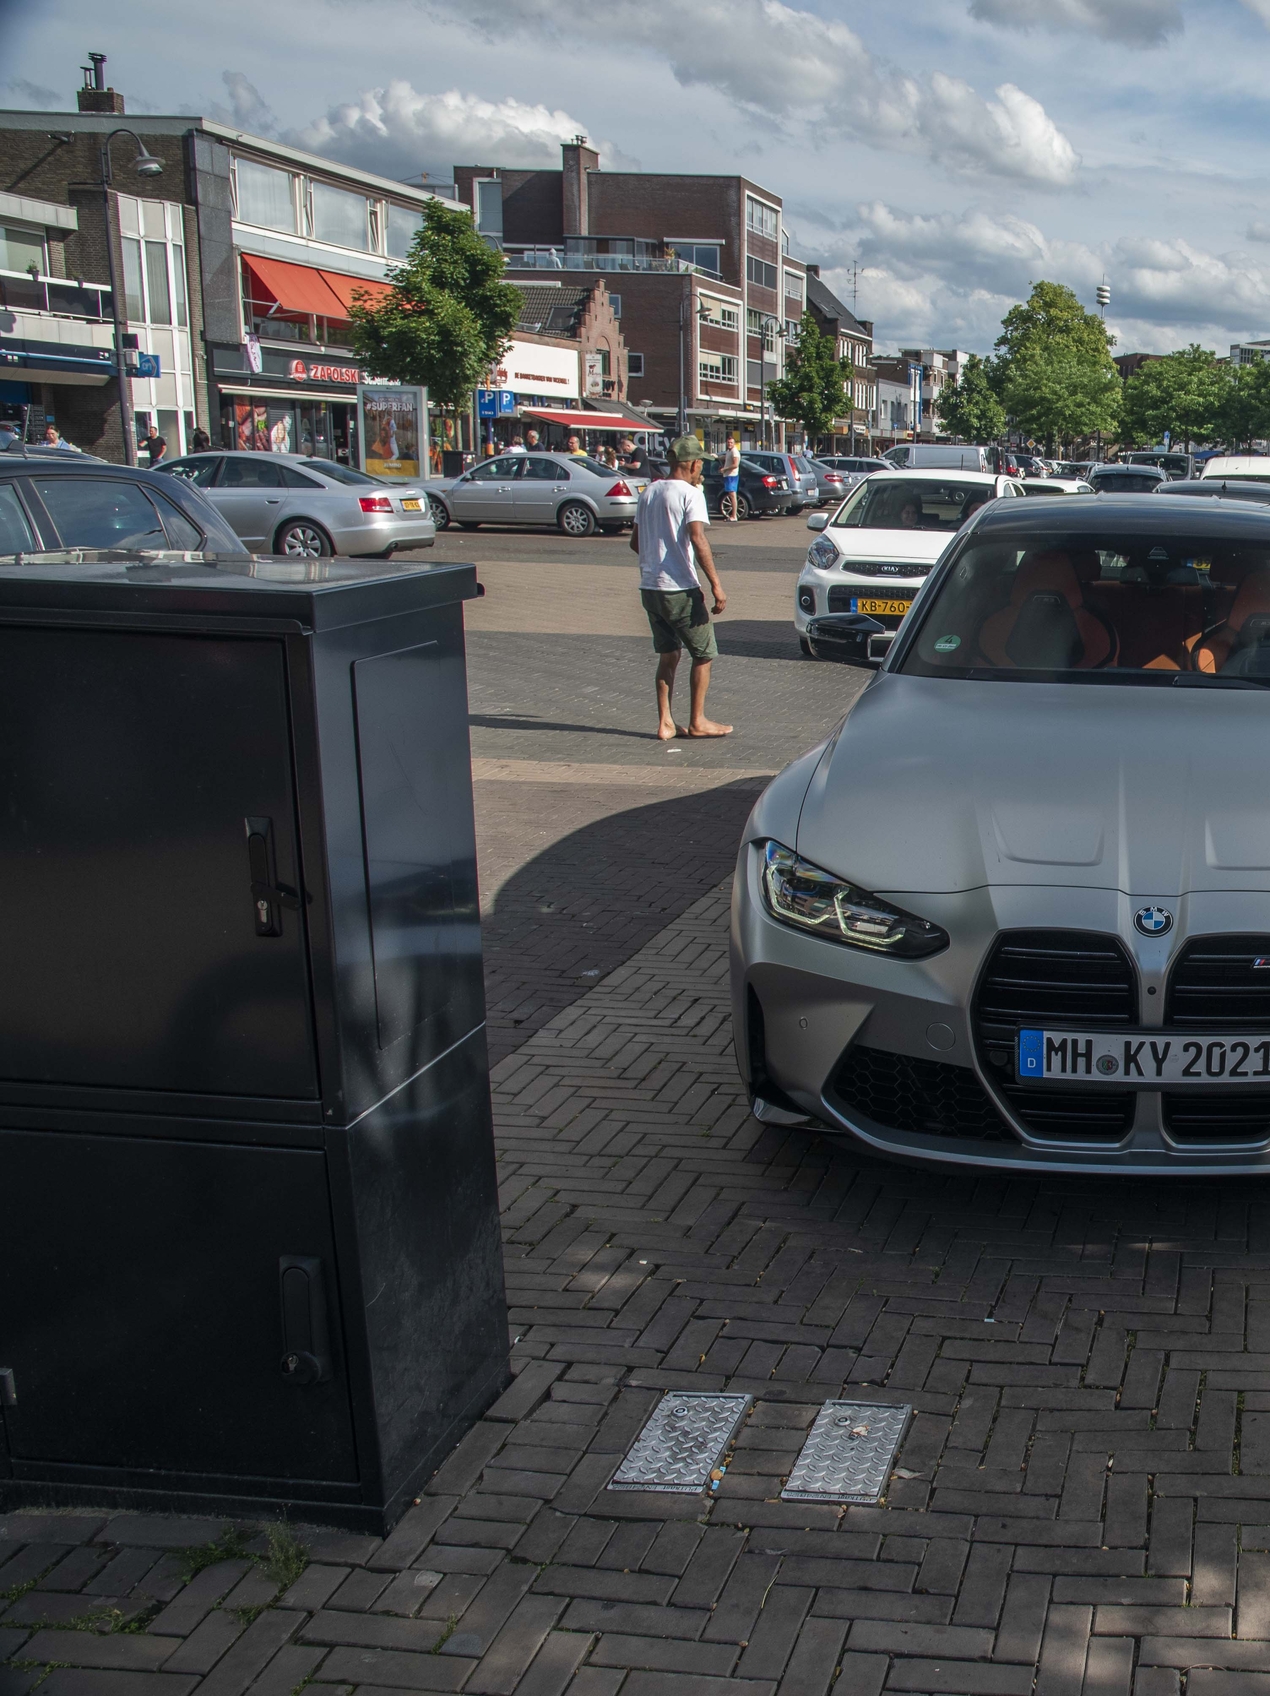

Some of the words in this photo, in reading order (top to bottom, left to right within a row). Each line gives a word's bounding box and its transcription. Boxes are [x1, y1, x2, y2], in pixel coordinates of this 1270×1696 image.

[310, 364, 359, 383] ZAPOLSKI
[485, 391, 494, 403] P
[503, 393, 511, 405] P
[367, 402, 413, 411] #SUPERFAN
[861, 601, 912, 612] KB-760-
[945, 635, 953, 643] 4
[1046, 1036, 1093, 1074] MH
[1123, 1040, 1171, 1077] KY
[1027, 1057, 1036, 1068] D
